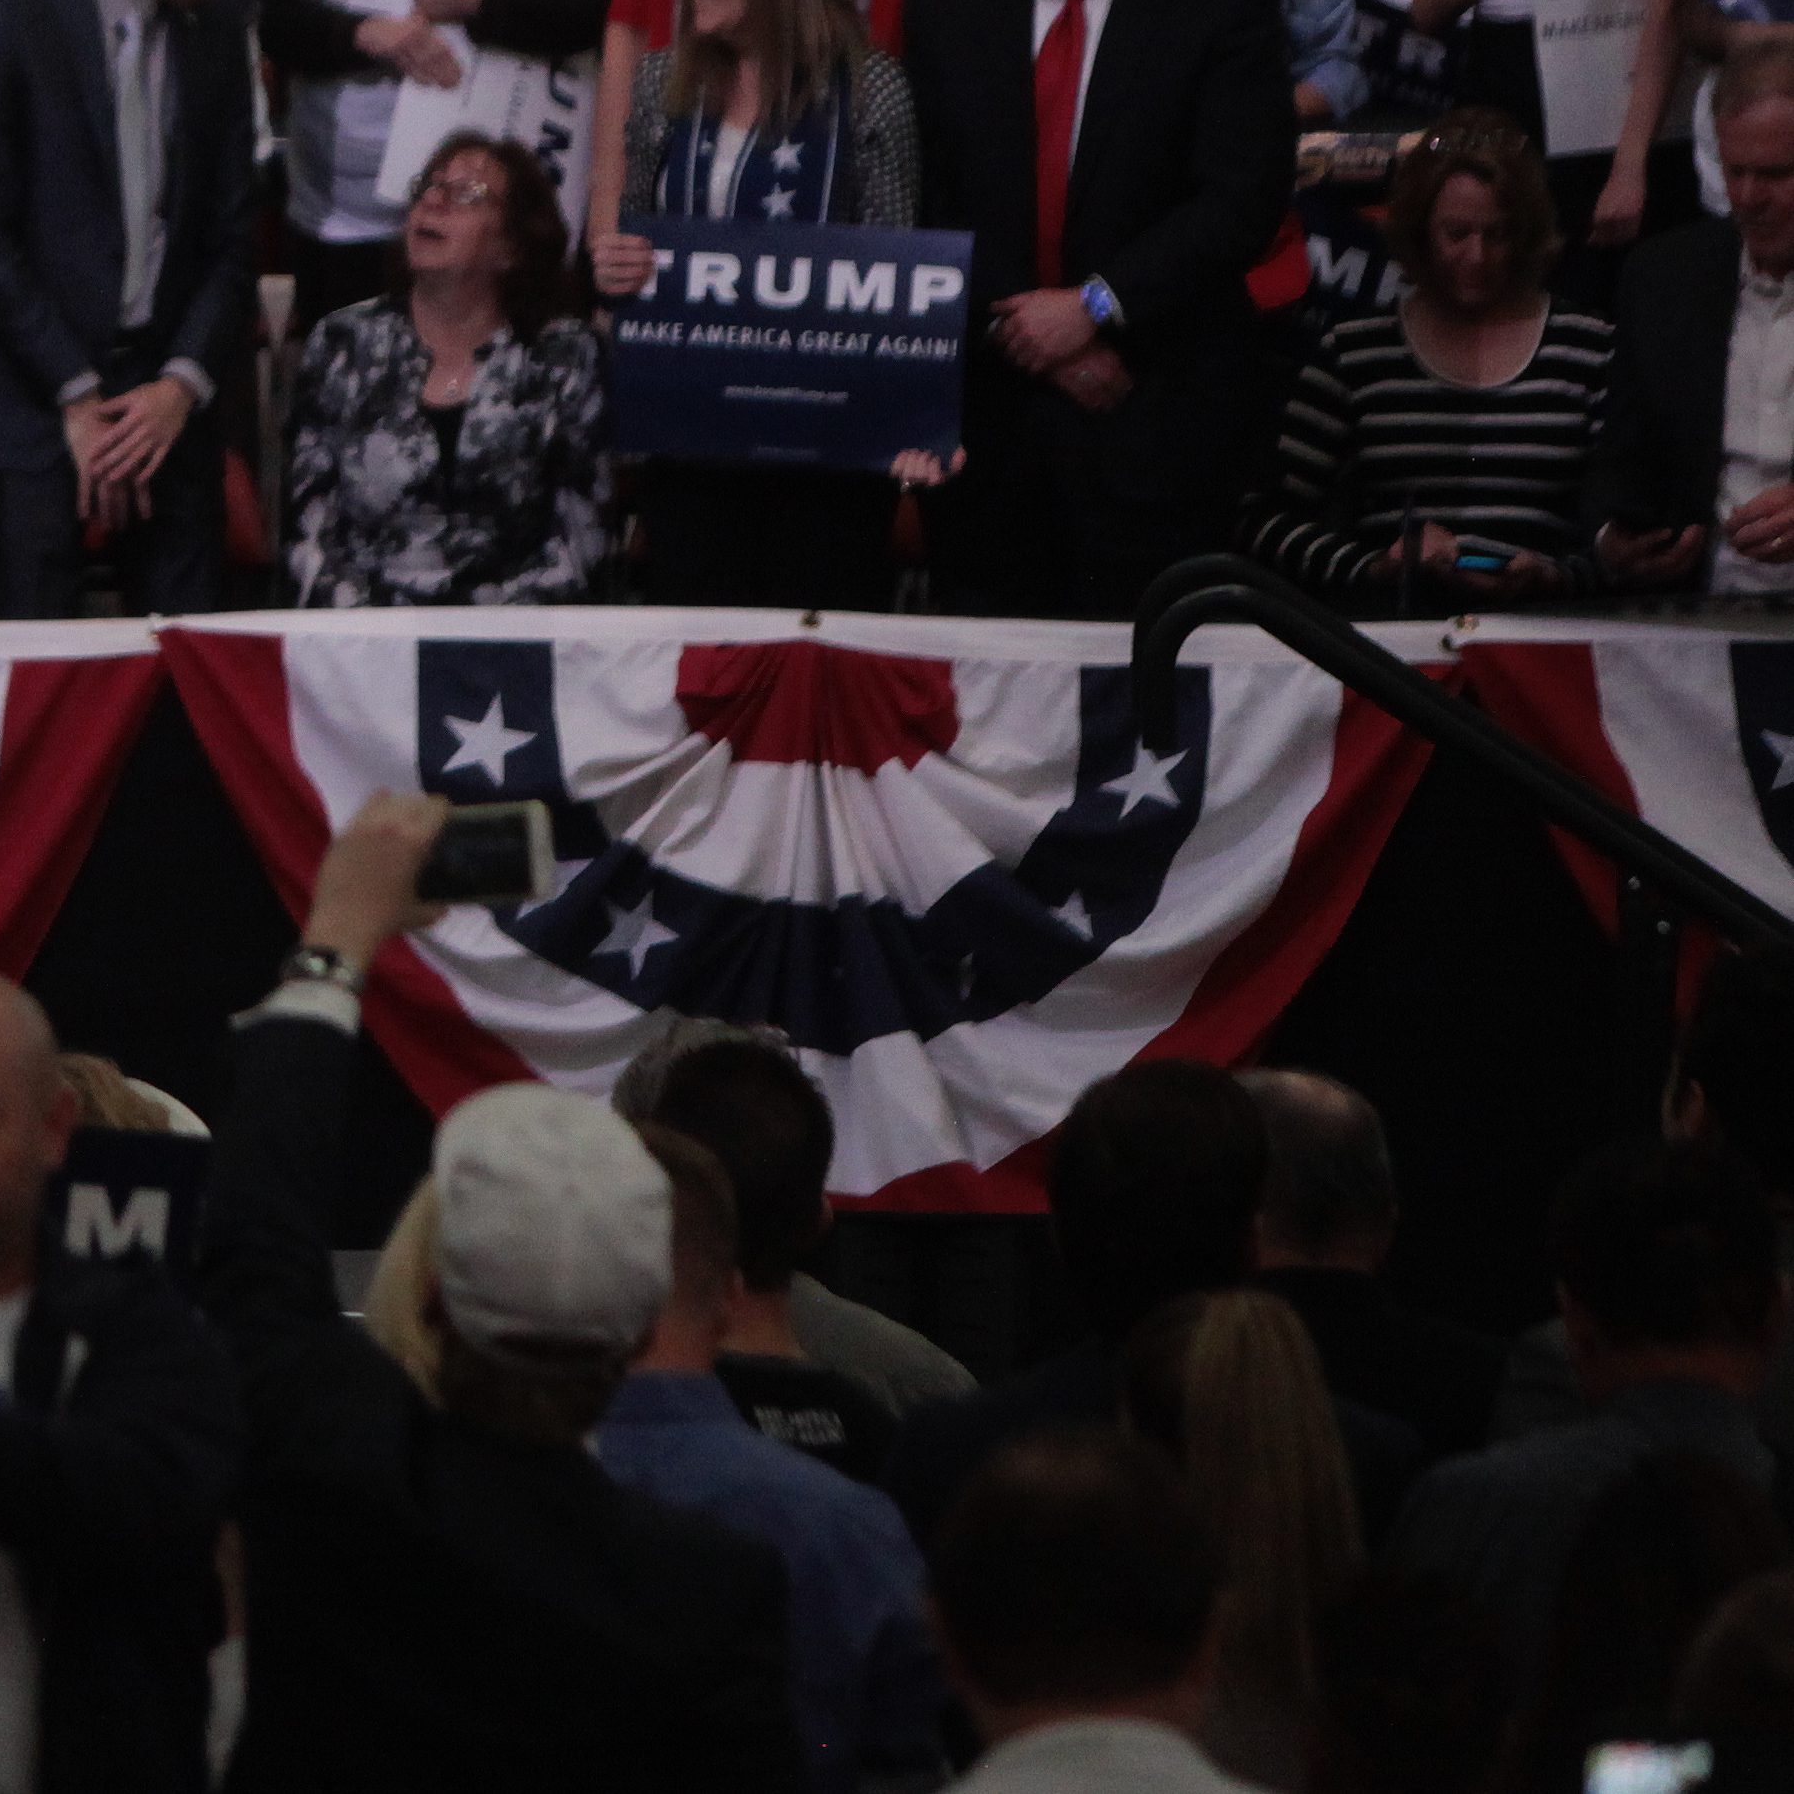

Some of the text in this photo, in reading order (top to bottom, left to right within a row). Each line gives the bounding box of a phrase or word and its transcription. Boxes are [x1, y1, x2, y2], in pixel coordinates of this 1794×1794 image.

[617, 319, 958, 362] MAKE AMERICA GREAT AGAIN!
